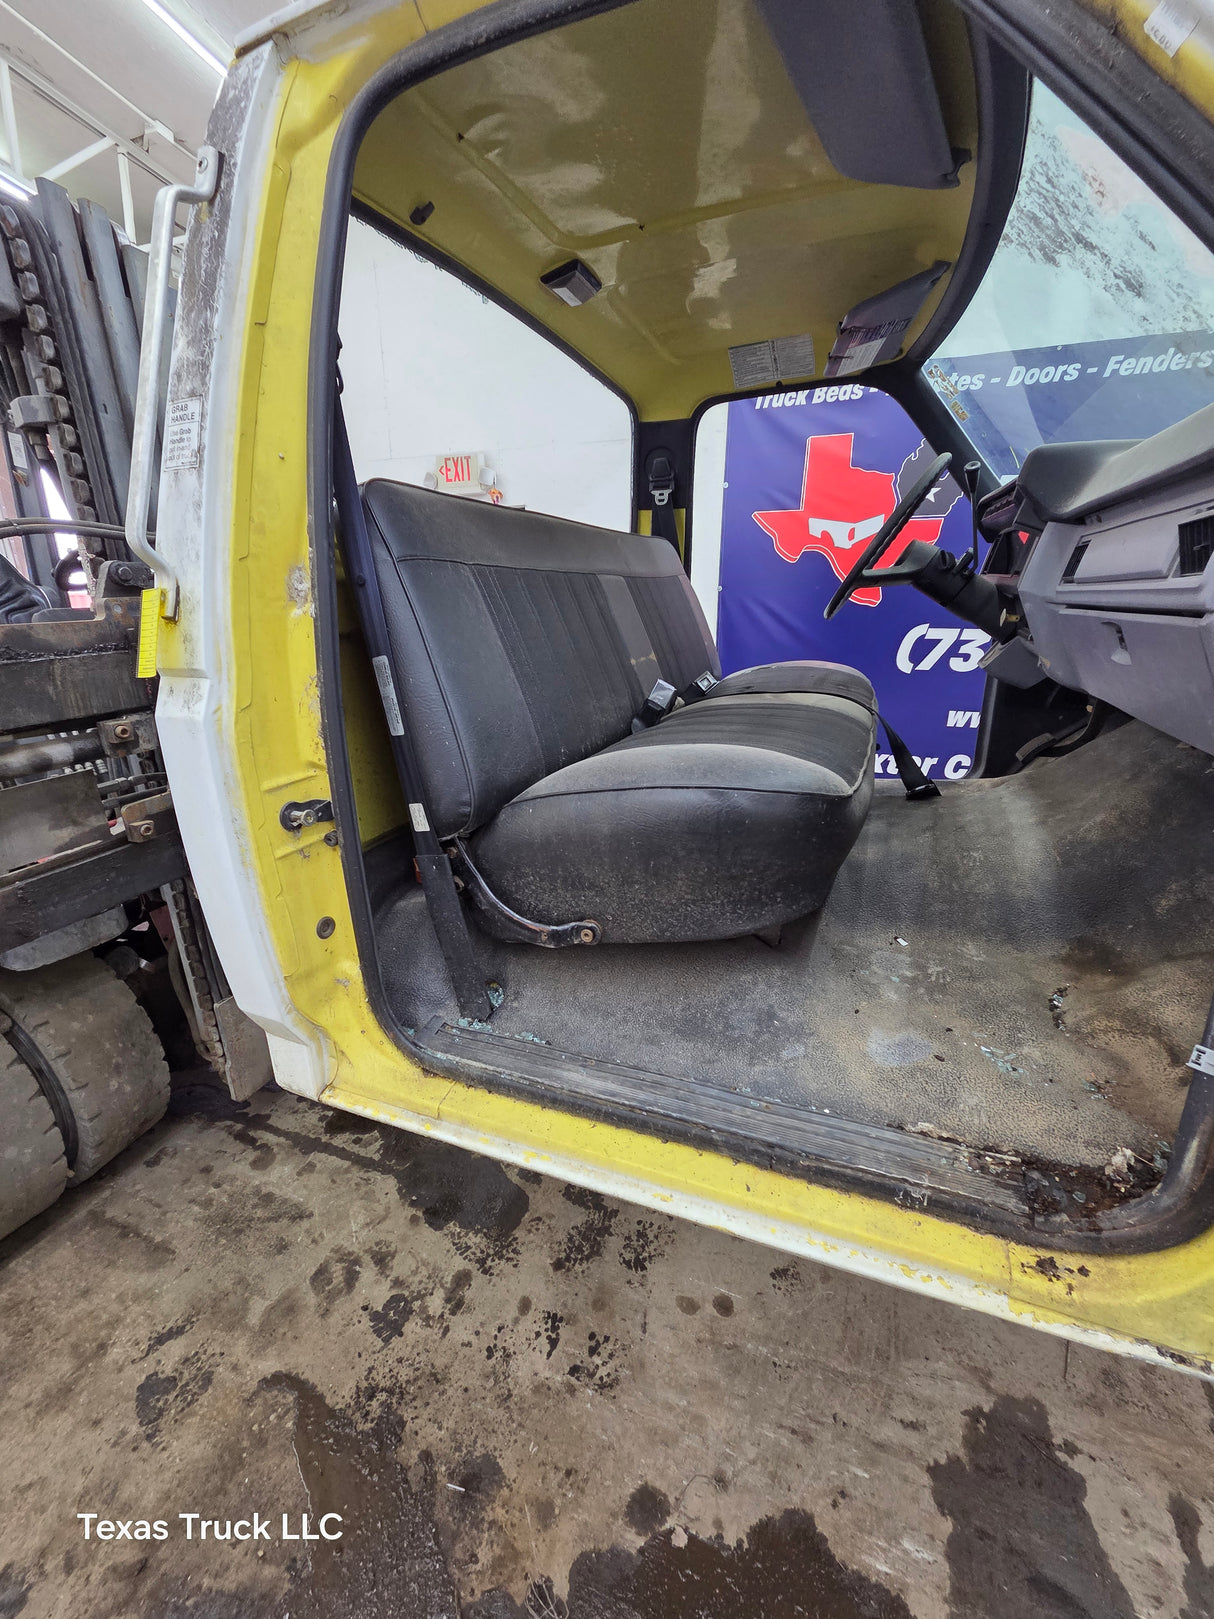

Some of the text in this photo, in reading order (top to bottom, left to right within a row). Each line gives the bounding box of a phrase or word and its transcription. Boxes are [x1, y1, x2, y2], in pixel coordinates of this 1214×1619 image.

[1006, 362, 1082, 387] Doors
[1102, 347, 1213, 378] Fenders
[171, 403, 189, 415] GRAB
[755, 389, 810, 410] Truck
[812, 384, 864, 404] Beds
[170, 411, 196, 424] HANDLE
[444, 455, 471, 482] EXIT
[896, 623, 992, 674] (73
